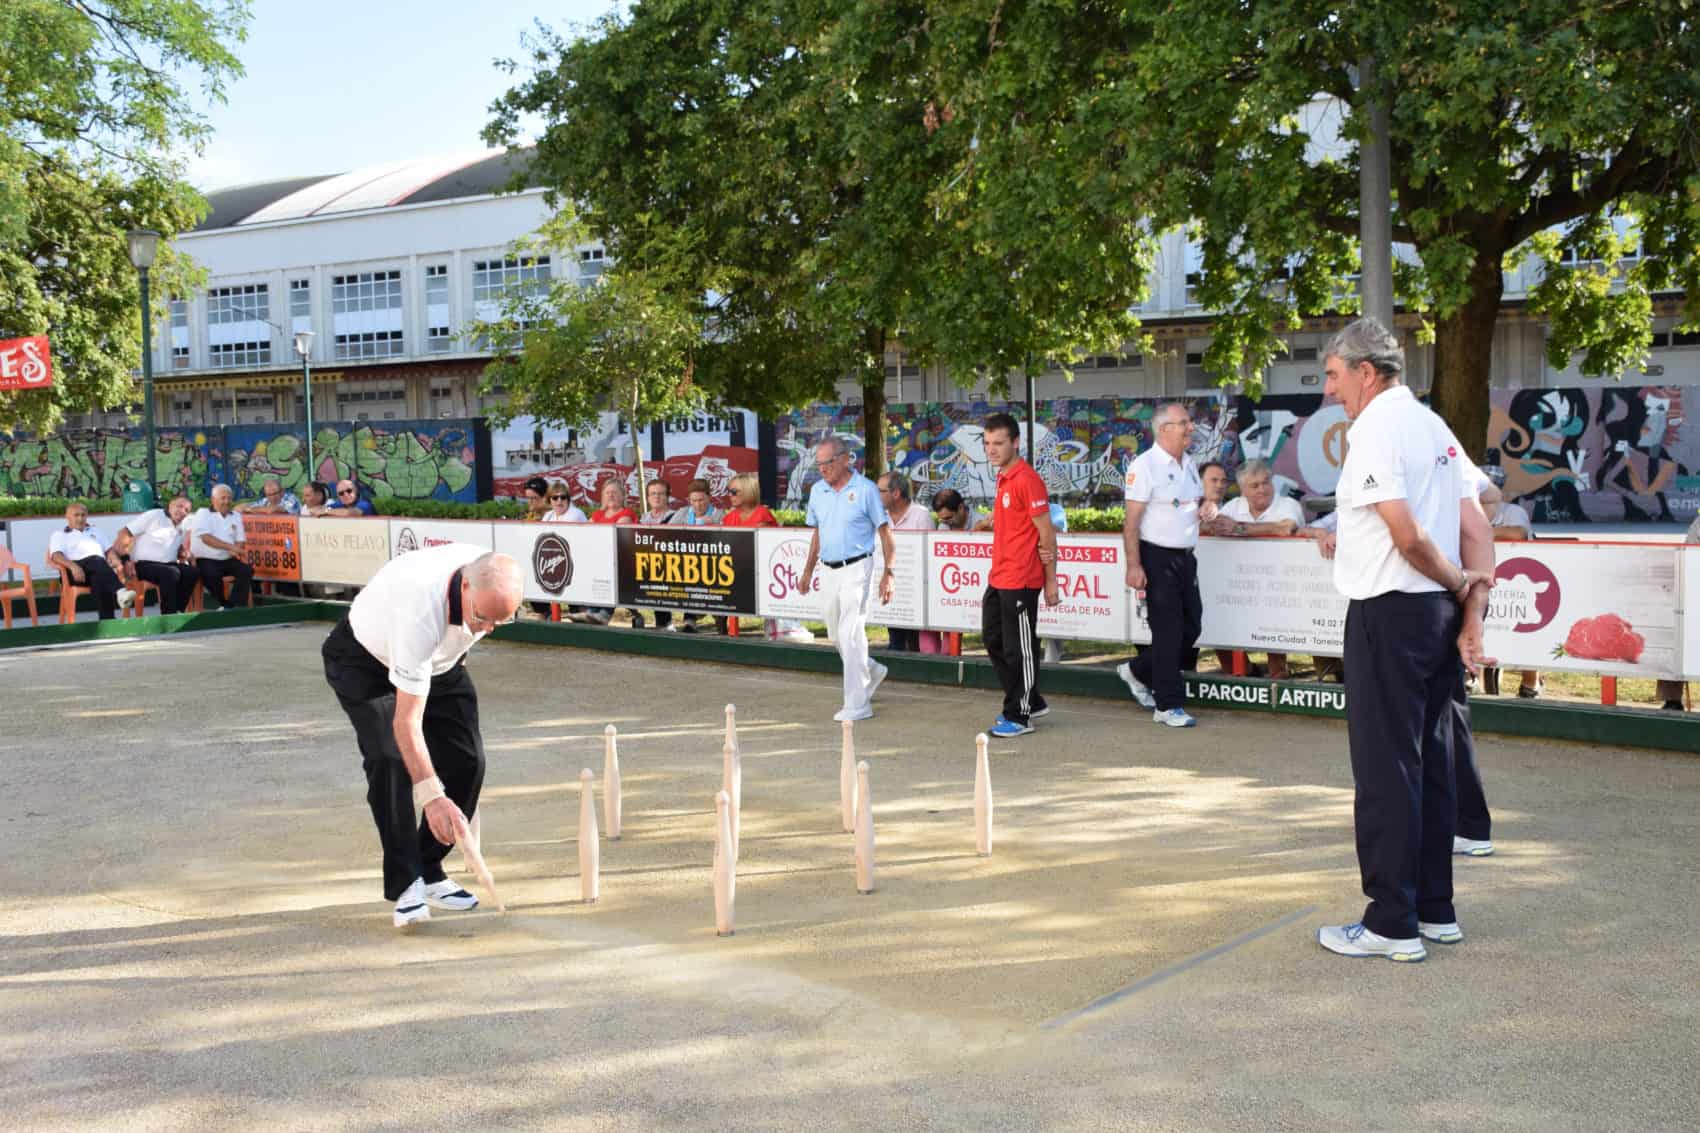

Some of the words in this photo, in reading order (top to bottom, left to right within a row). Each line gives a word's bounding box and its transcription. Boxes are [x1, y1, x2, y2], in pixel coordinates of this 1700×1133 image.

[635, 531, 654, 544] bar
[655, 540, 731, 554] restaurante
[635, 552, 735, 586] FERBUS
[1079, 606, 1090, 615] DE
[1093, 606, 1111, 616] PAS
[1277, 634, 1306, 644] Ciudad
[1199, 683, 1269, 704] PARQUE
[1279, 689, 1345, 710] ARTIPU
